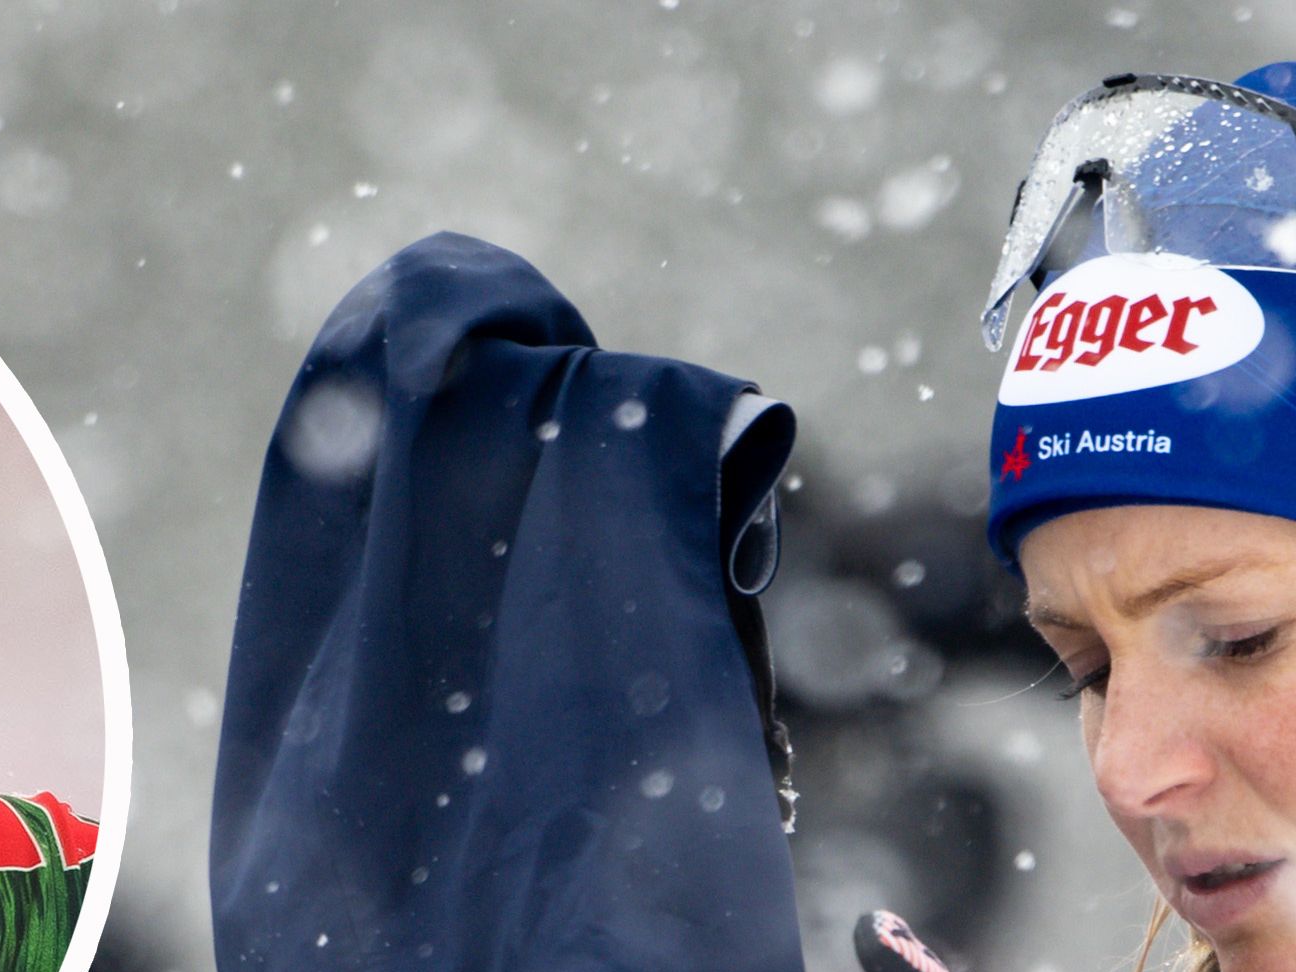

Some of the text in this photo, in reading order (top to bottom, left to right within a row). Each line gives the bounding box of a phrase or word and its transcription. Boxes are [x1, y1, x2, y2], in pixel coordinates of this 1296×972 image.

[1014, 292, 1218, 373] Egger
[1038, 429, 1172, 460] Ski Austria
